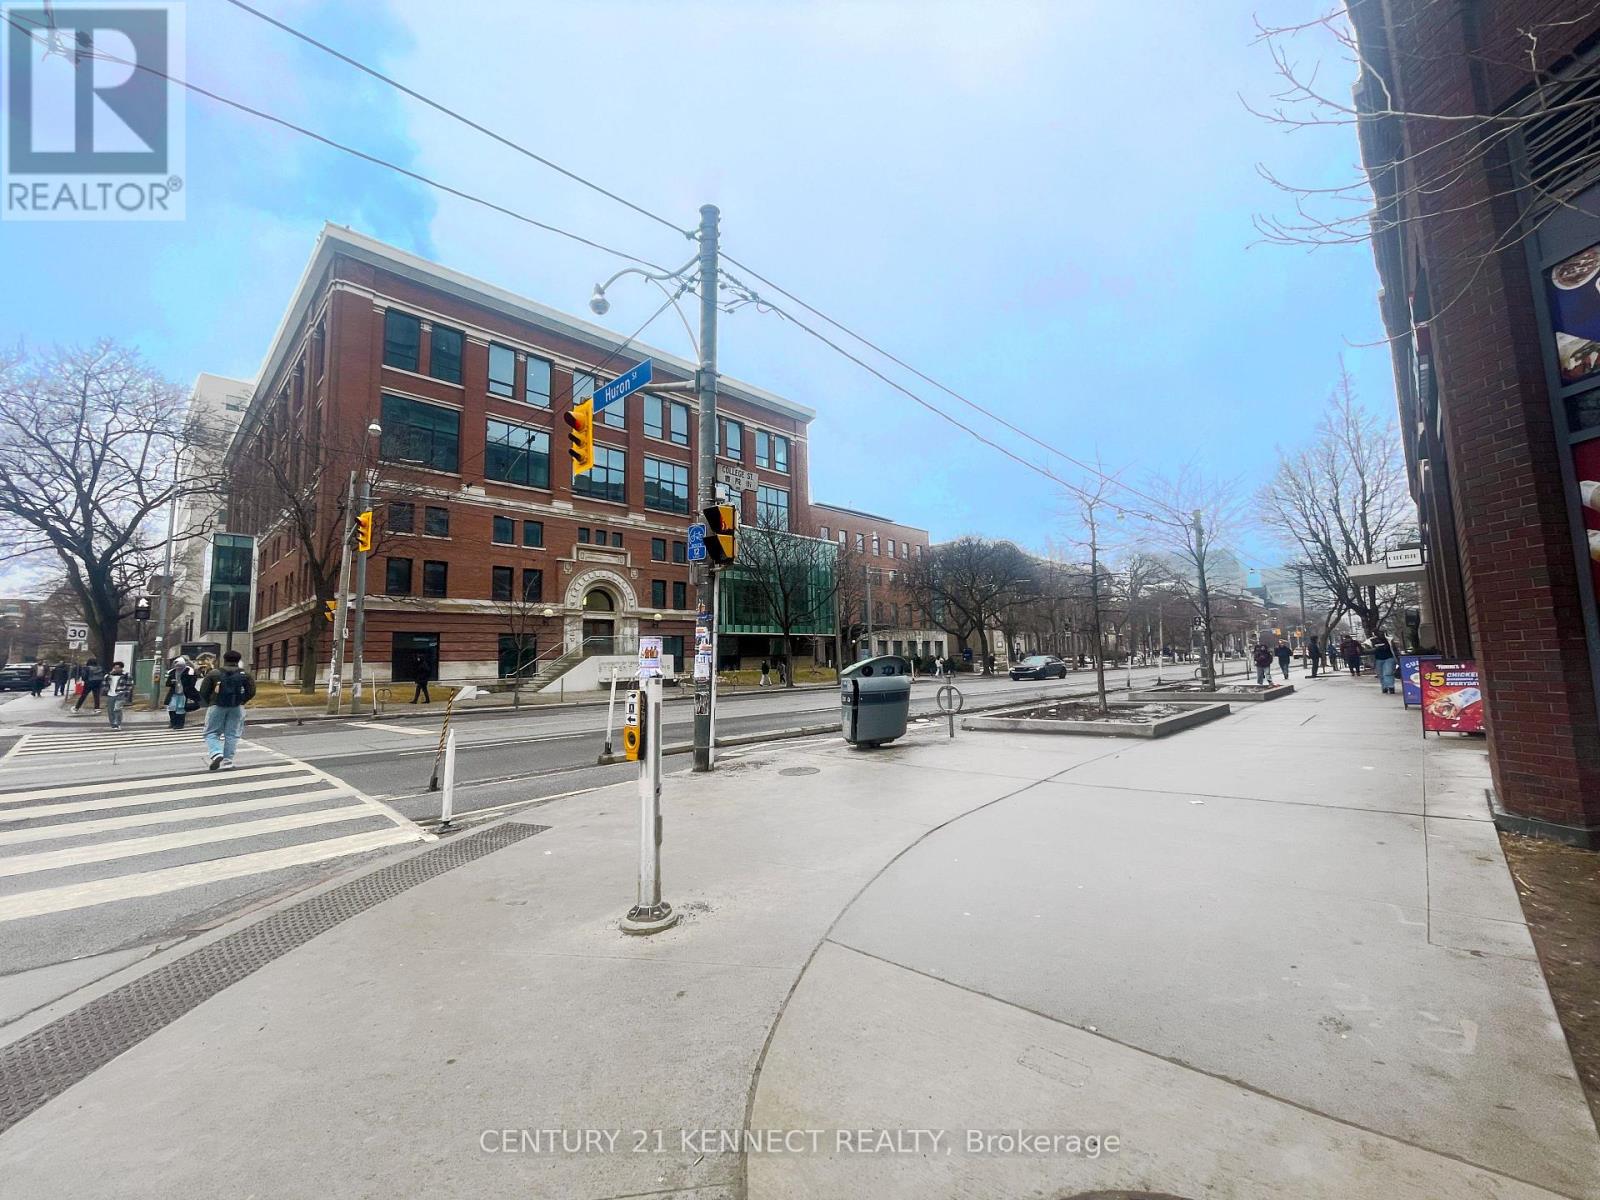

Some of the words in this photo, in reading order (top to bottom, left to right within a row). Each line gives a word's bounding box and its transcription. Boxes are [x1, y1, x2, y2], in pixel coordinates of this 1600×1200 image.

[605, 378, 631, 403] Huron
[721, 465, 745, 479] COLLEGE
[68, 629, 87, 638] 30
[1424, 671, 1445, 687] $5
